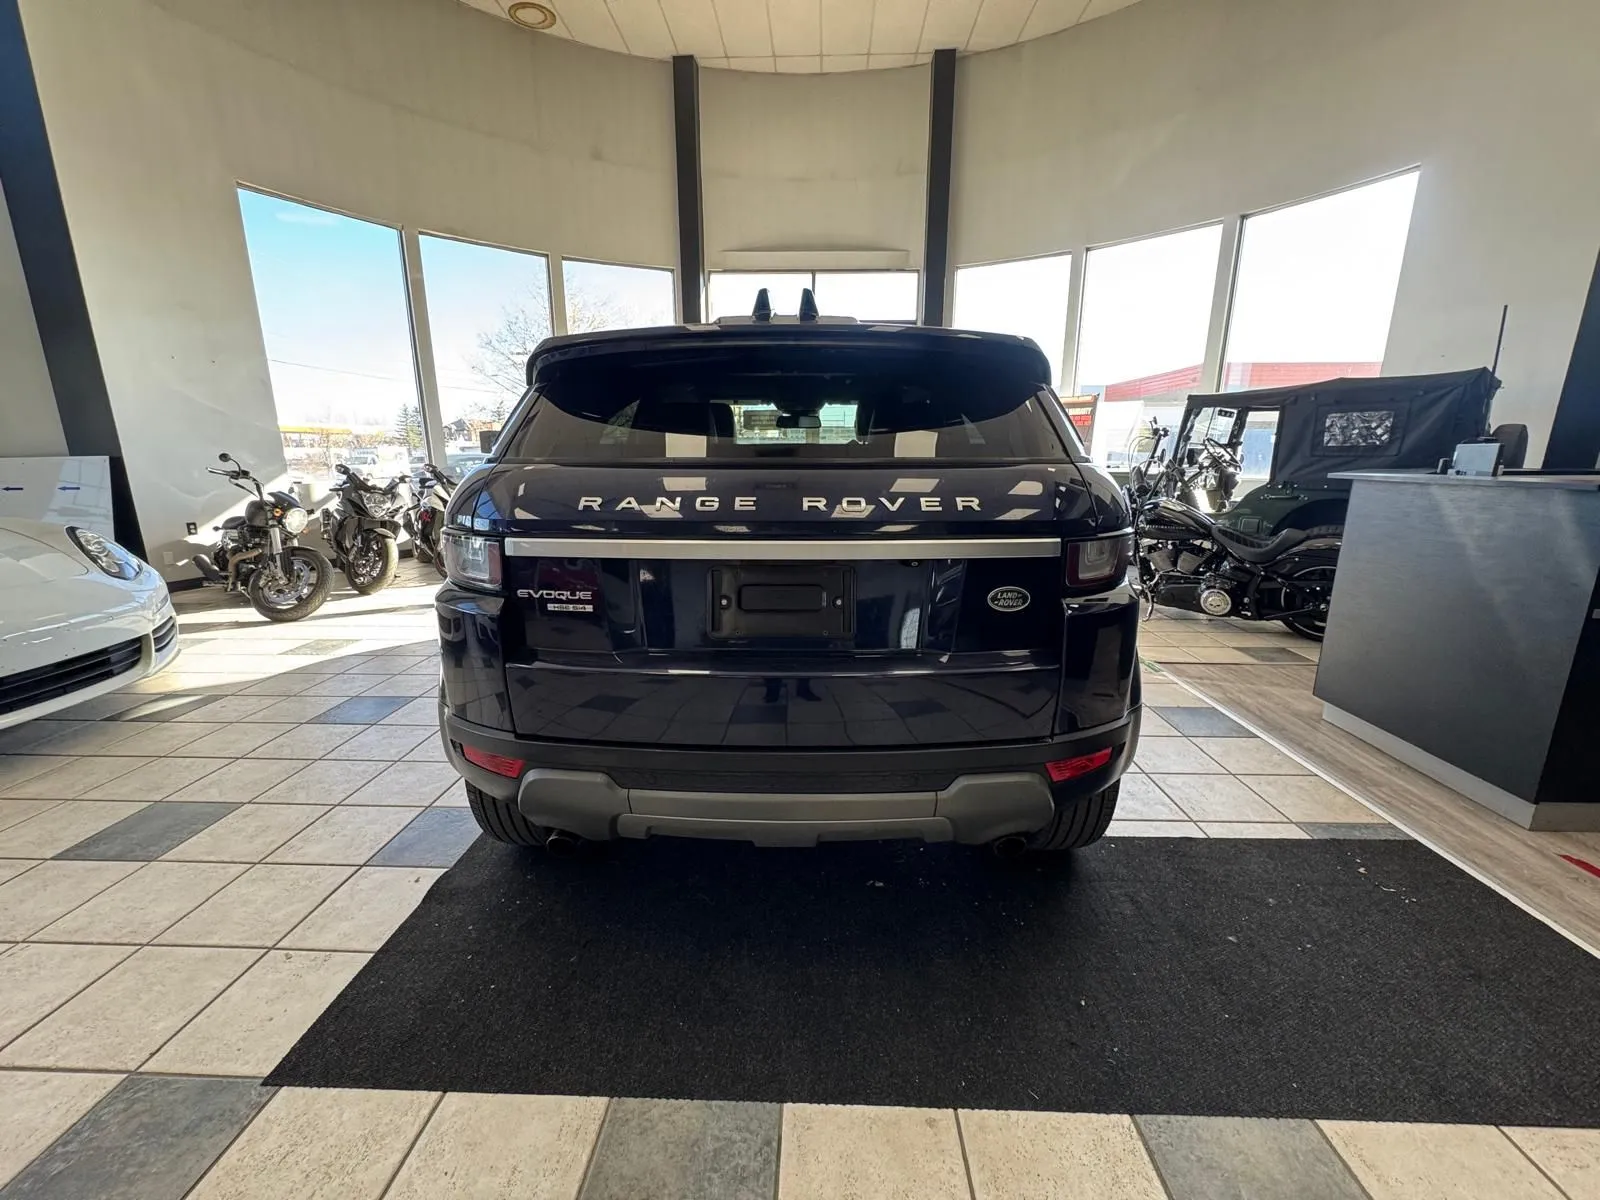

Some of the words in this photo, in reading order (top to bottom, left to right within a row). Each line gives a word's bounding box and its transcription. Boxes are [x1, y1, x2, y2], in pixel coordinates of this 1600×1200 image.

[578, 496, 757, 511] RANGE
[802, 496, 982, 511] ROVER
[516, 589, 593, 601] EVOQUE
